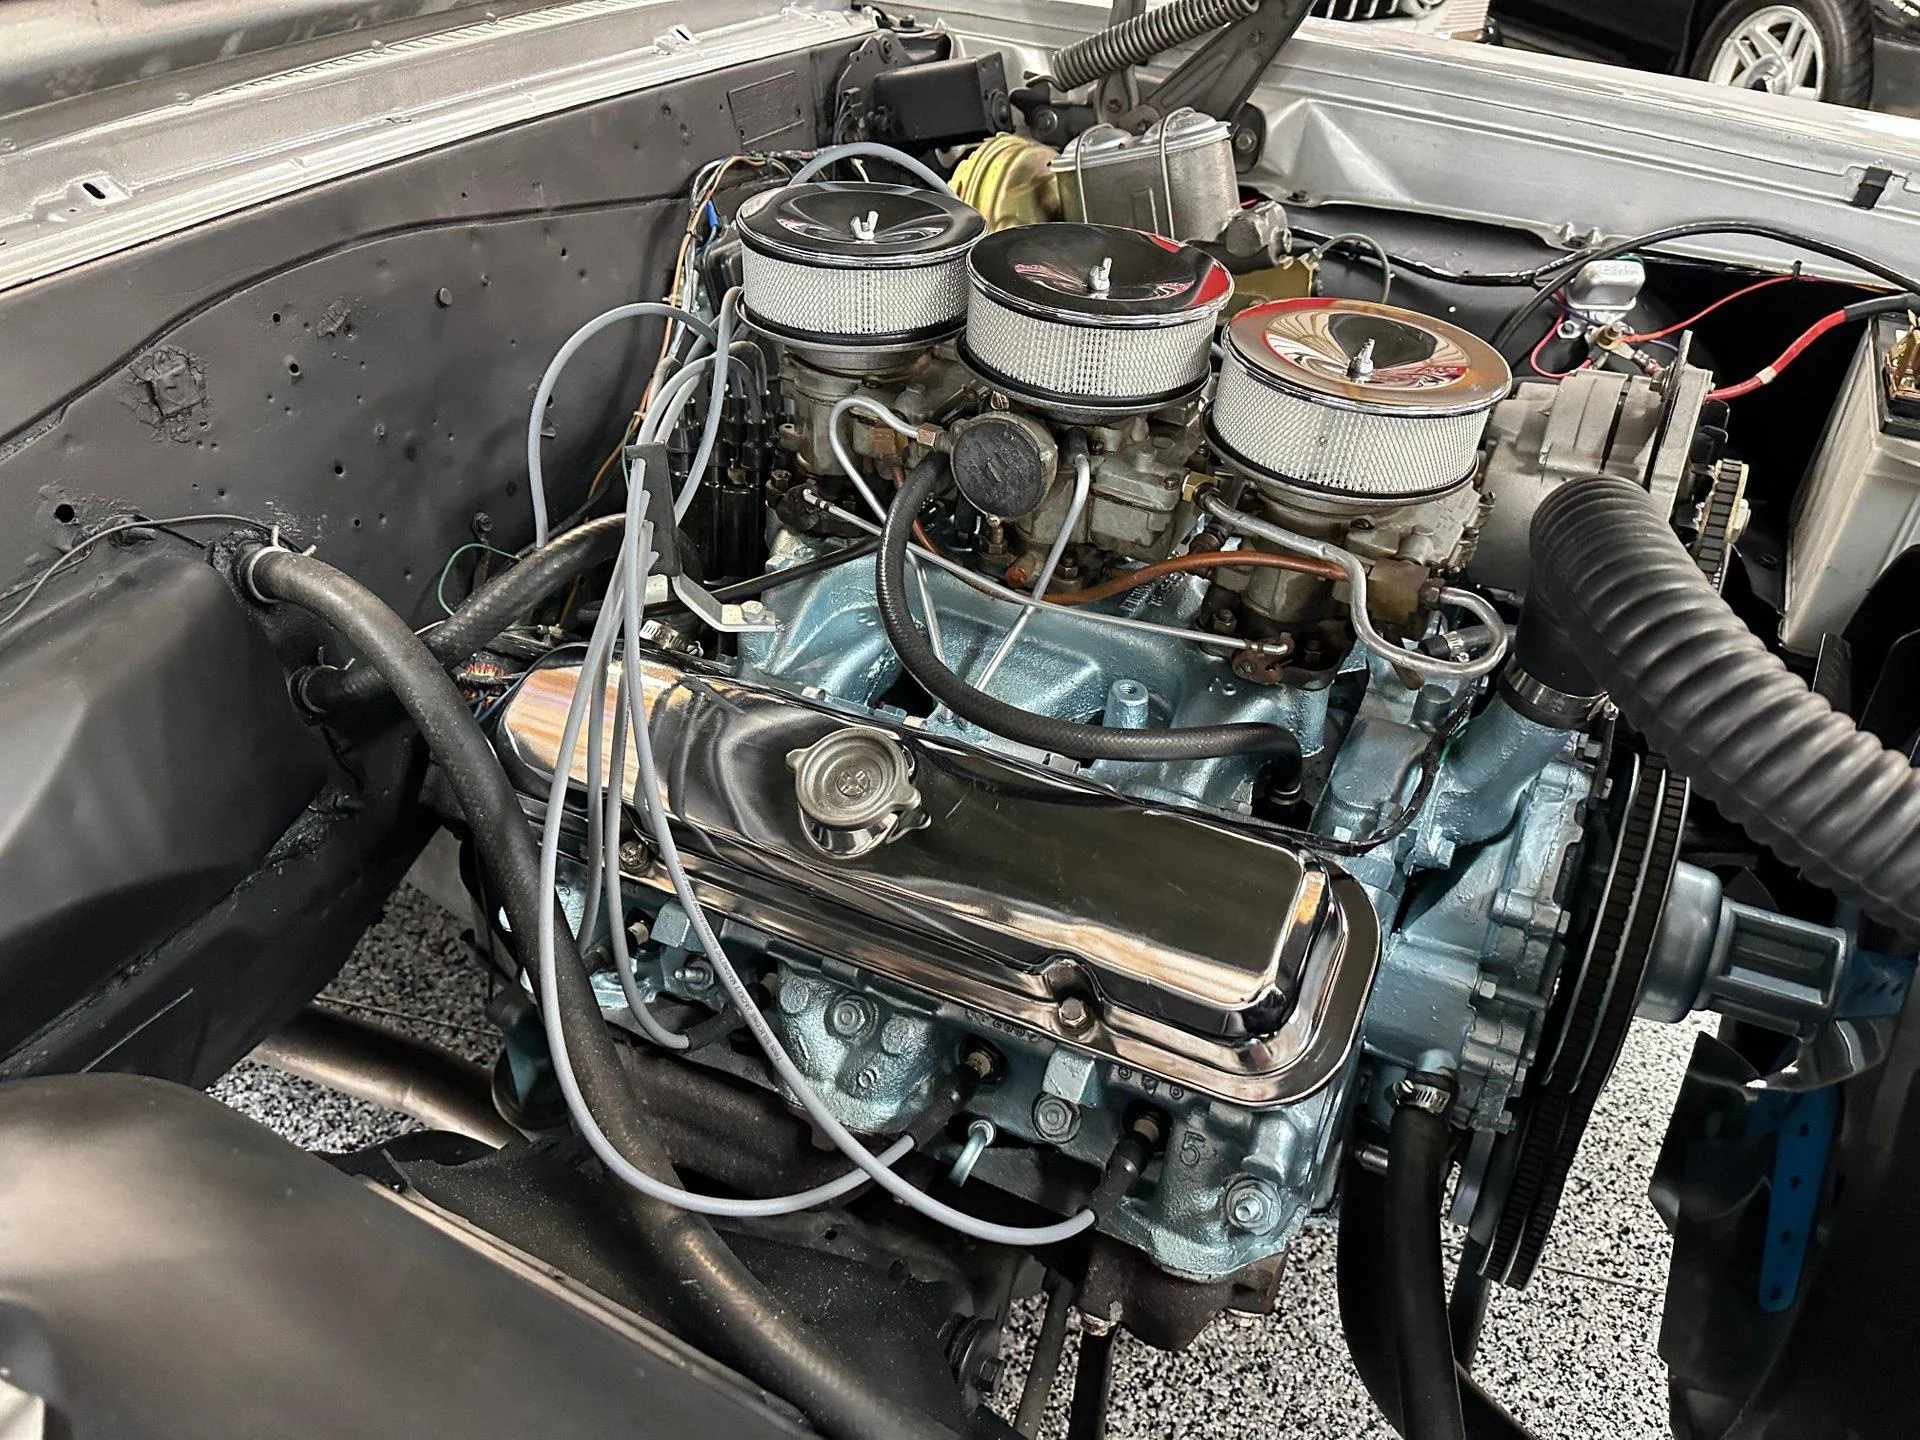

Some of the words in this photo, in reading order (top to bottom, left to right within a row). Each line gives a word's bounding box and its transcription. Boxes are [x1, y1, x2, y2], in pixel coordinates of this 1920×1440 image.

[715, 949, 737, 985] MAGNETIC
[735, 985, 753, 1011] JACKET
[749, 1011, 772, 1045] SILICONE
[768, 1044, 782, 1061] 7mm
[1181, 1130, 1207, 1167] 5
